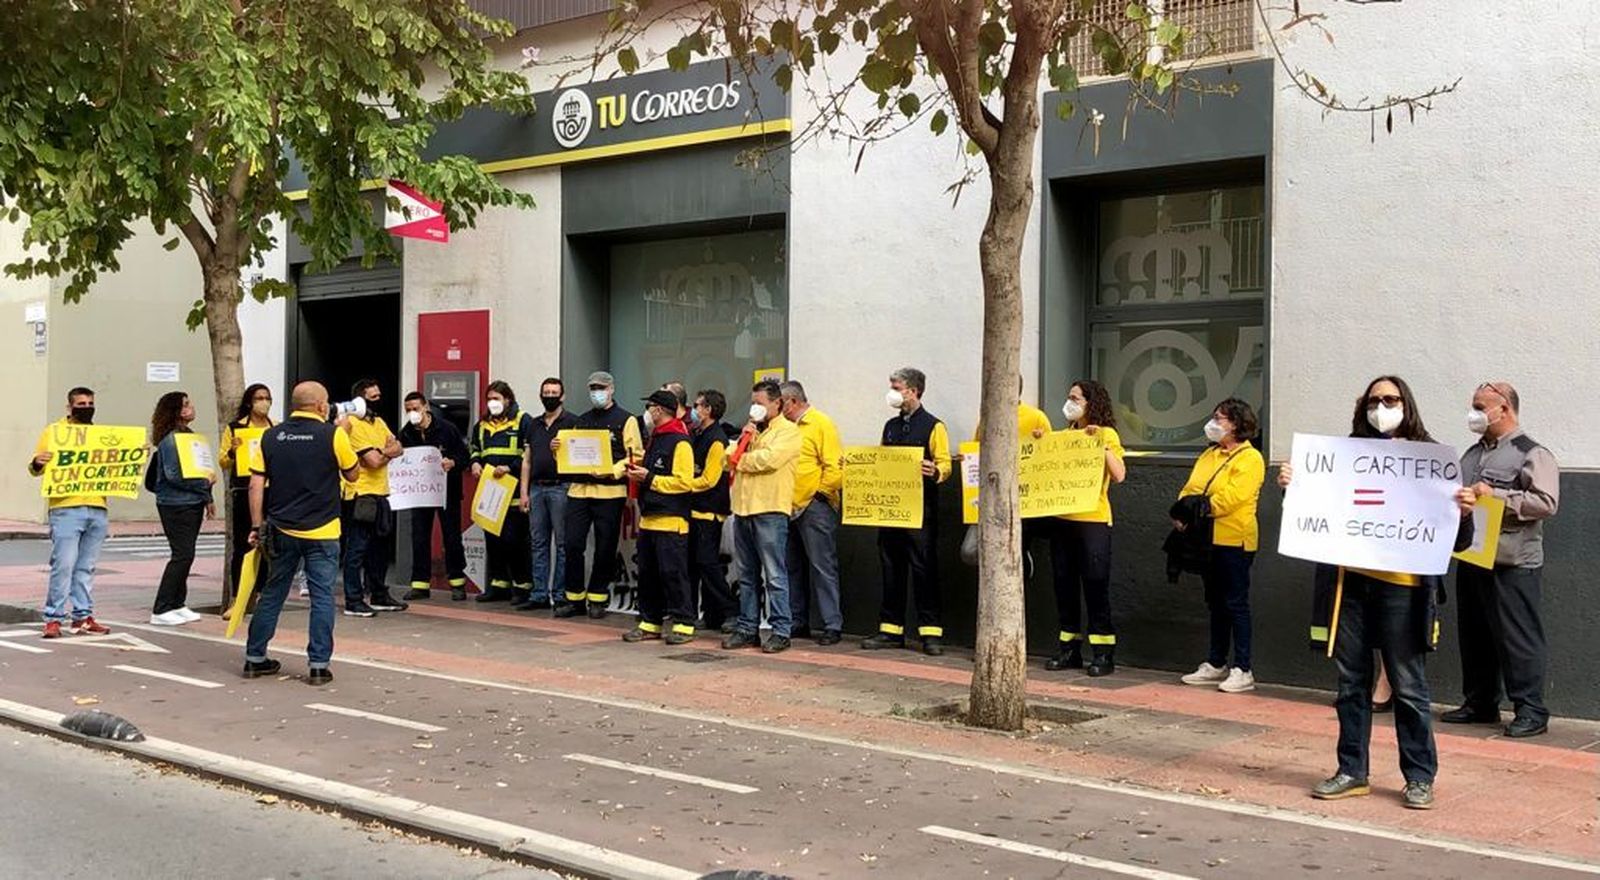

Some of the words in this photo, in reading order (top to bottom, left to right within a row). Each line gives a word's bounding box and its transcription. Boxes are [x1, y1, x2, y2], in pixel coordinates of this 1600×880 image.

[597, 94, 627, 129] TU
[631, 80, 741, 123] CORREOS
[53, 425, 88, 447] UN
[57, 447, 144, 467] BARRIO
[1021, 444, 1034, 455] NO
[50, 466, 81, 484] UN
[83, 463, 143, 479] CARTER
[1306, 453, 1335, 474] UN
[1353, 456, 1458, 480] CARTERO
[1297, 517, 1330, 534] UNA
